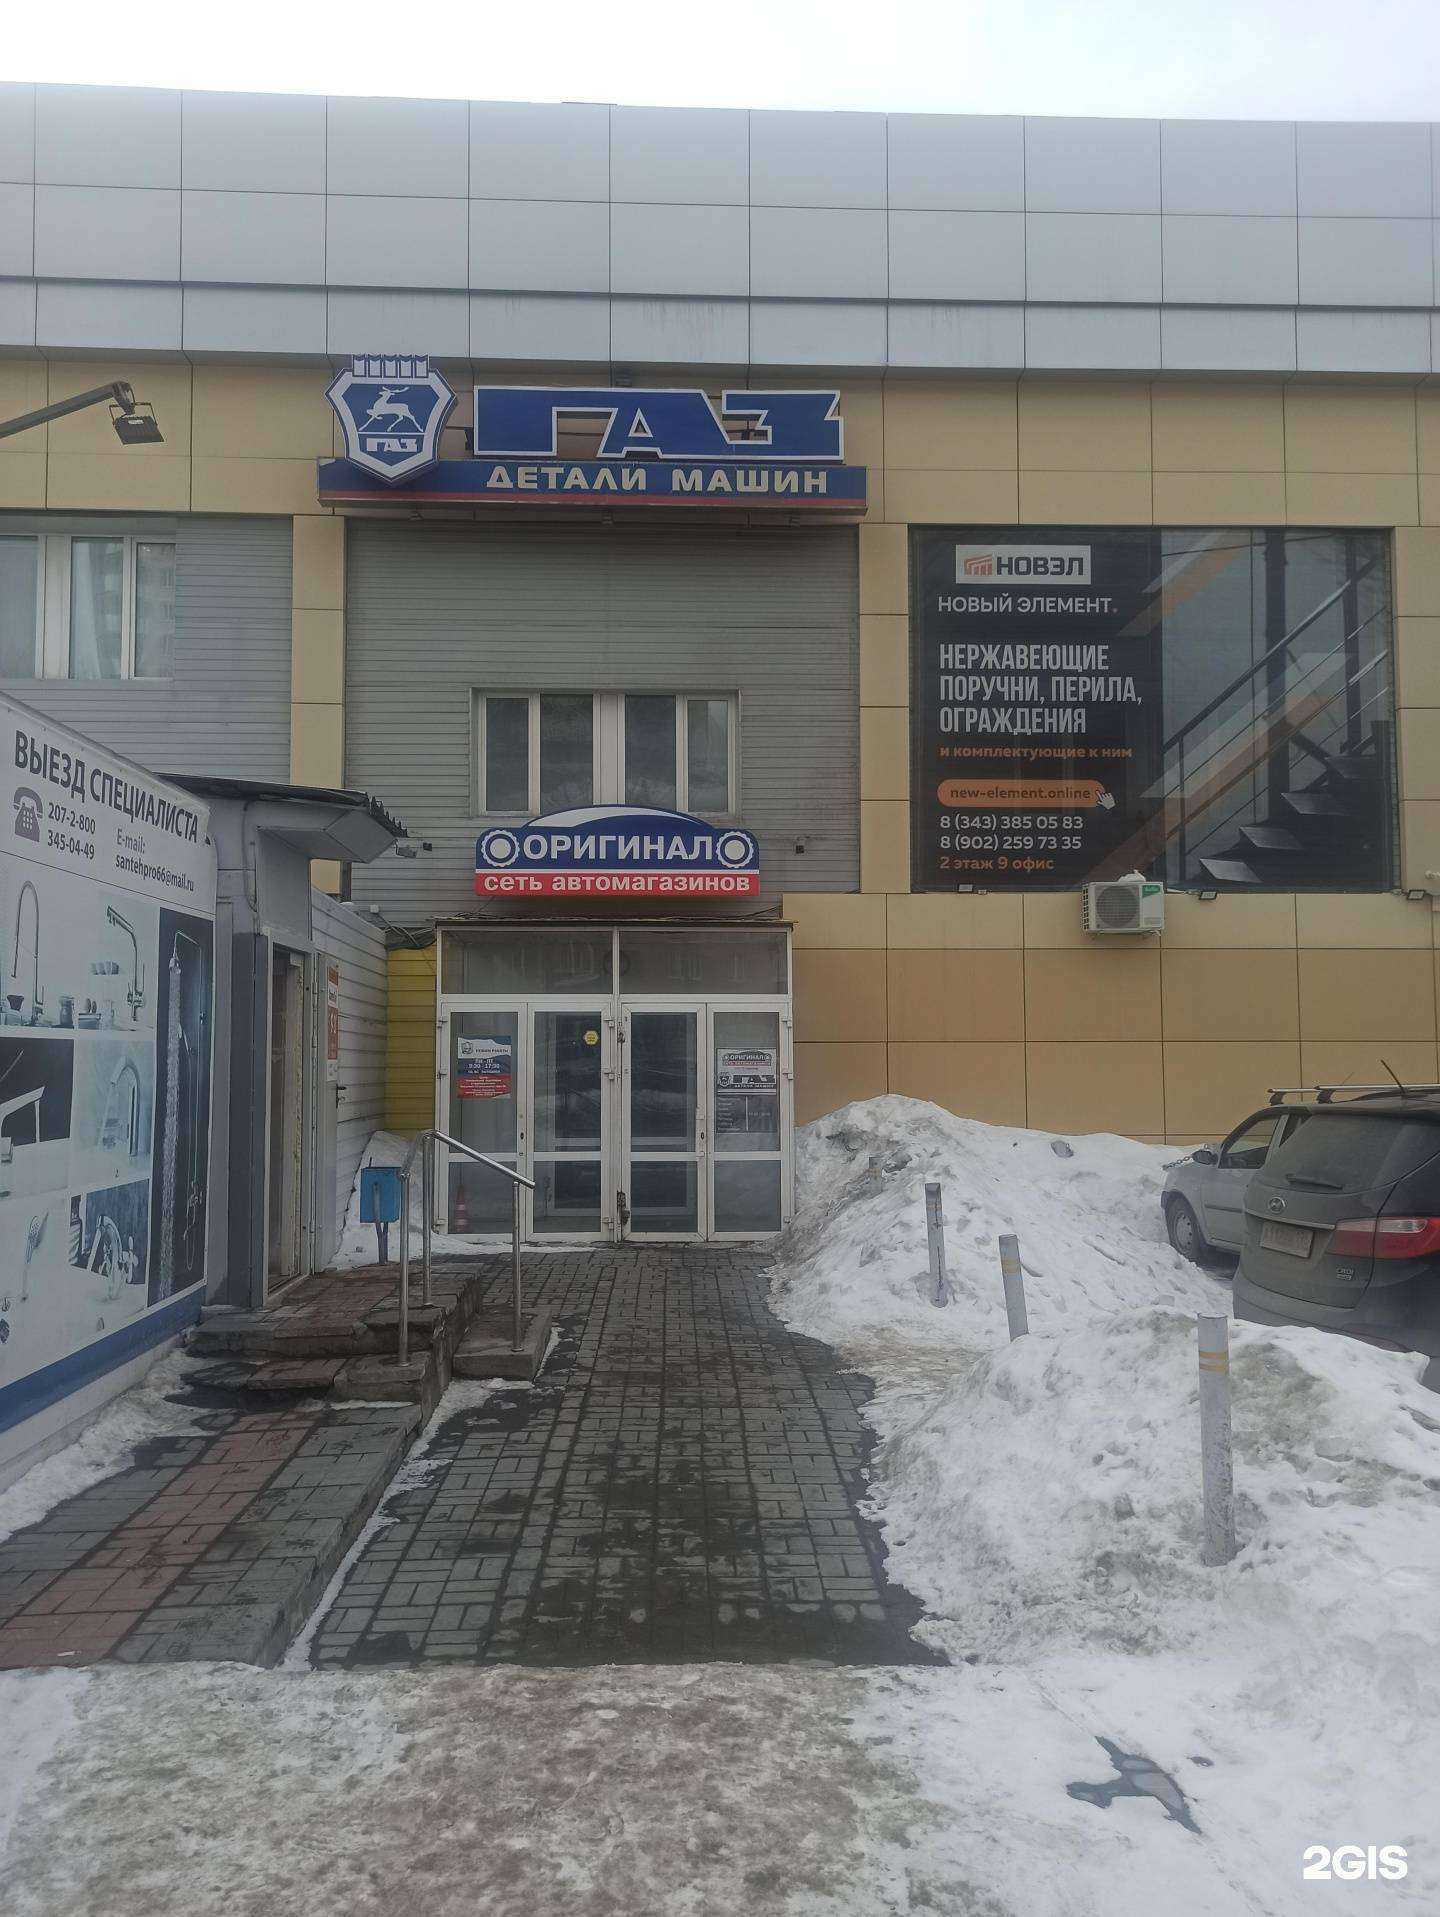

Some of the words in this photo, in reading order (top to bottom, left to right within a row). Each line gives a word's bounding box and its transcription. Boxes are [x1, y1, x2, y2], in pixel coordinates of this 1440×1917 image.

[473, 384, 845, 461] ГАЗ
[366, 438, 418, 453] ГАЗ
[486, 465, 648, 492] ДЕТАЛИ
[672, 469, 828, 494] МАШИН
[996, 556, 1084, 576] НОВЭЛ
[938, 593, 1012, 613] НОВЫЙ
[939, 643, 1109, 672] НЕРЖАВЕЮЩИЕ
[939, 675, 1045, 705] ПОРУЧНИ,
[1051, 676, 1143, 705] ПЕРИЛА,
[939, 707, 1087, 736] ОГРАЖДЕНИЯ
[940, 747, 950, 757] и
[954, 747, 1086, 761] комплектующие
[1089, 747, 1098, 758] к
[1102, 747, 1132, 758] ним
[14, 729, 86, 804] ВЫЕЗД
[89, 768, 199, 844] СПЕЦИАЛИСТА
[950, 786, 1091, 799] new-element.online
[47, 802, 96, 835] 207-2-800
[940, 816, 951, 829] 8
[955, 815, 997, 832] (343)
[1001, 816, 1032, 830] 385
[1036, 816, 1058, 830] 05
[1062, 816, 1084, 830] 83
[47, 829, 95, 861] 345-04-49
[116, 828, 146, 854] E-mail:
[522, 834, 713, 861] ОРИГИНАЛ
[940, 837, 951, 850] 8
[955, 835, 999, 852] (902)
[1003, 836, 1034, 850] 259
[1037, 836, 1058, 850] 73
[1061, 836, 1082, 850] 35
[115, 853, 195, 892] santehpro66@mail.ru
[940, 857, 950, 870] 2
[954, 858, 994, 871] этаж
[997, 857, 1008, 870] 9
[1012, 856, 1054, 873] офис
[483, 875, 543, 891] сеть
[552, 875, 751, 891] автомагазинов
